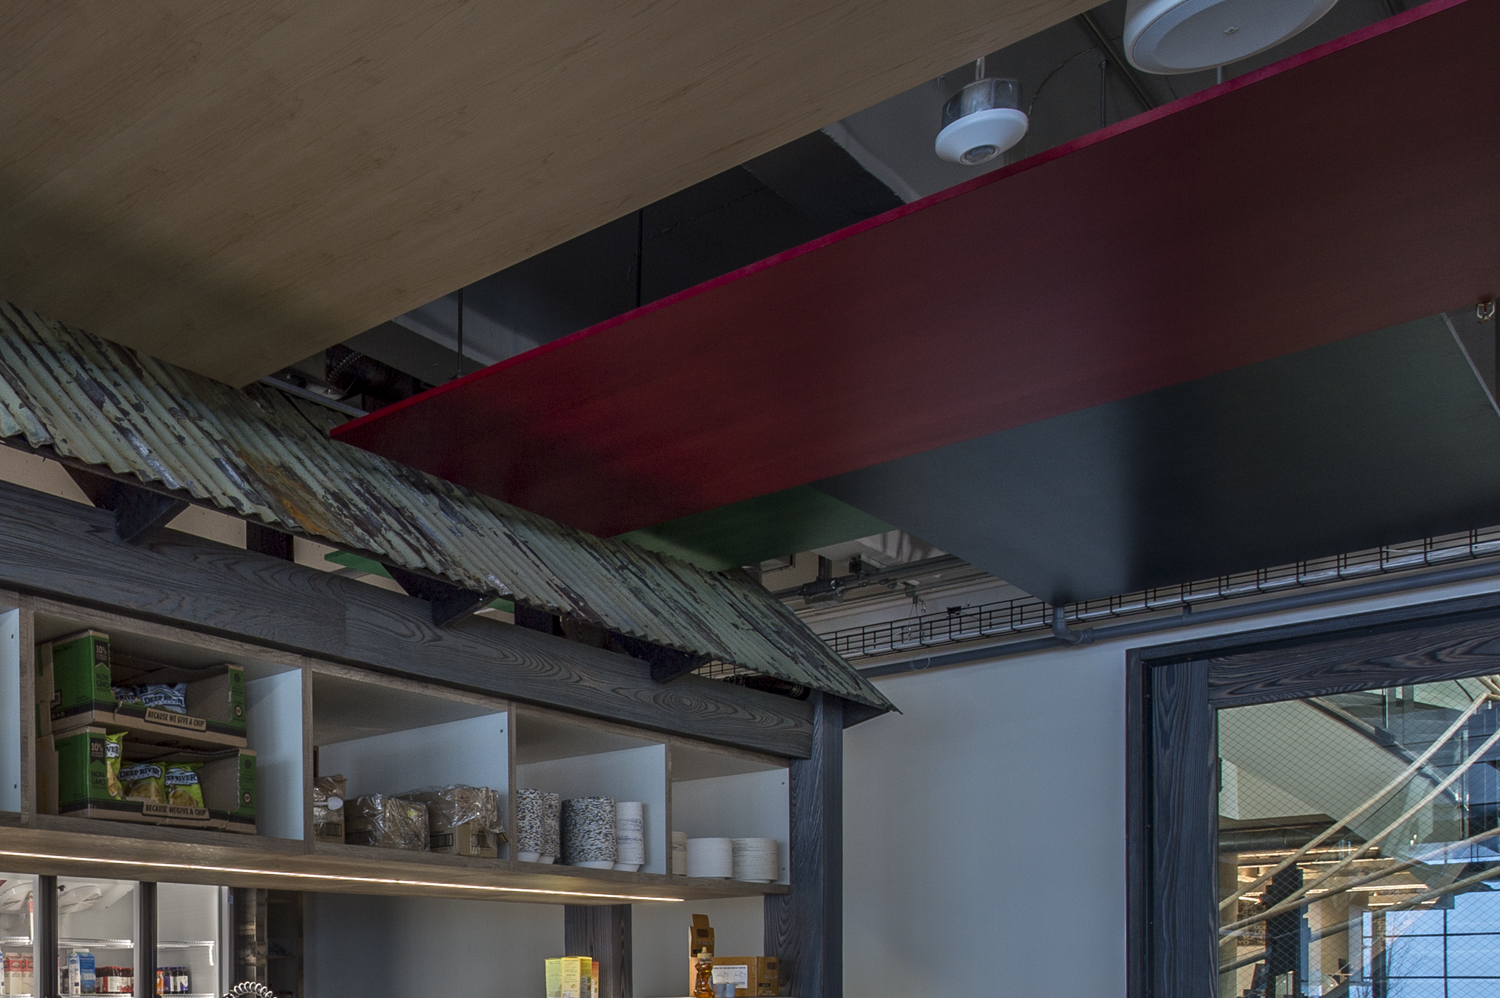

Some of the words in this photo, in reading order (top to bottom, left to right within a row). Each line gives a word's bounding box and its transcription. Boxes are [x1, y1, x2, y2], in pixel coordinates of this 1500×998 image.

[95, 645, 107, 655] 10%
[96, 673, 108, 681] NON
[96, 680, 109, 688] GMO
[144, 696, 163, 705] DEEP
[148, 710, 169, 722] BECAUSE
[169, 715, 177, 723] WE
[177, 716, 188, 725] GIVE
[189, 718, 193, 726] A
[193, 719, 204, 727] CHIP
[91, 742, 104, 752] 10%
[119, 769, 140, 779] DEEP
[140, 767, 161, 777] RIVER
[175, 773, 197, 781] RIVER
[145, 804, 168, 813] BECAUSE
[175, 807, 189, 815] GIVE
